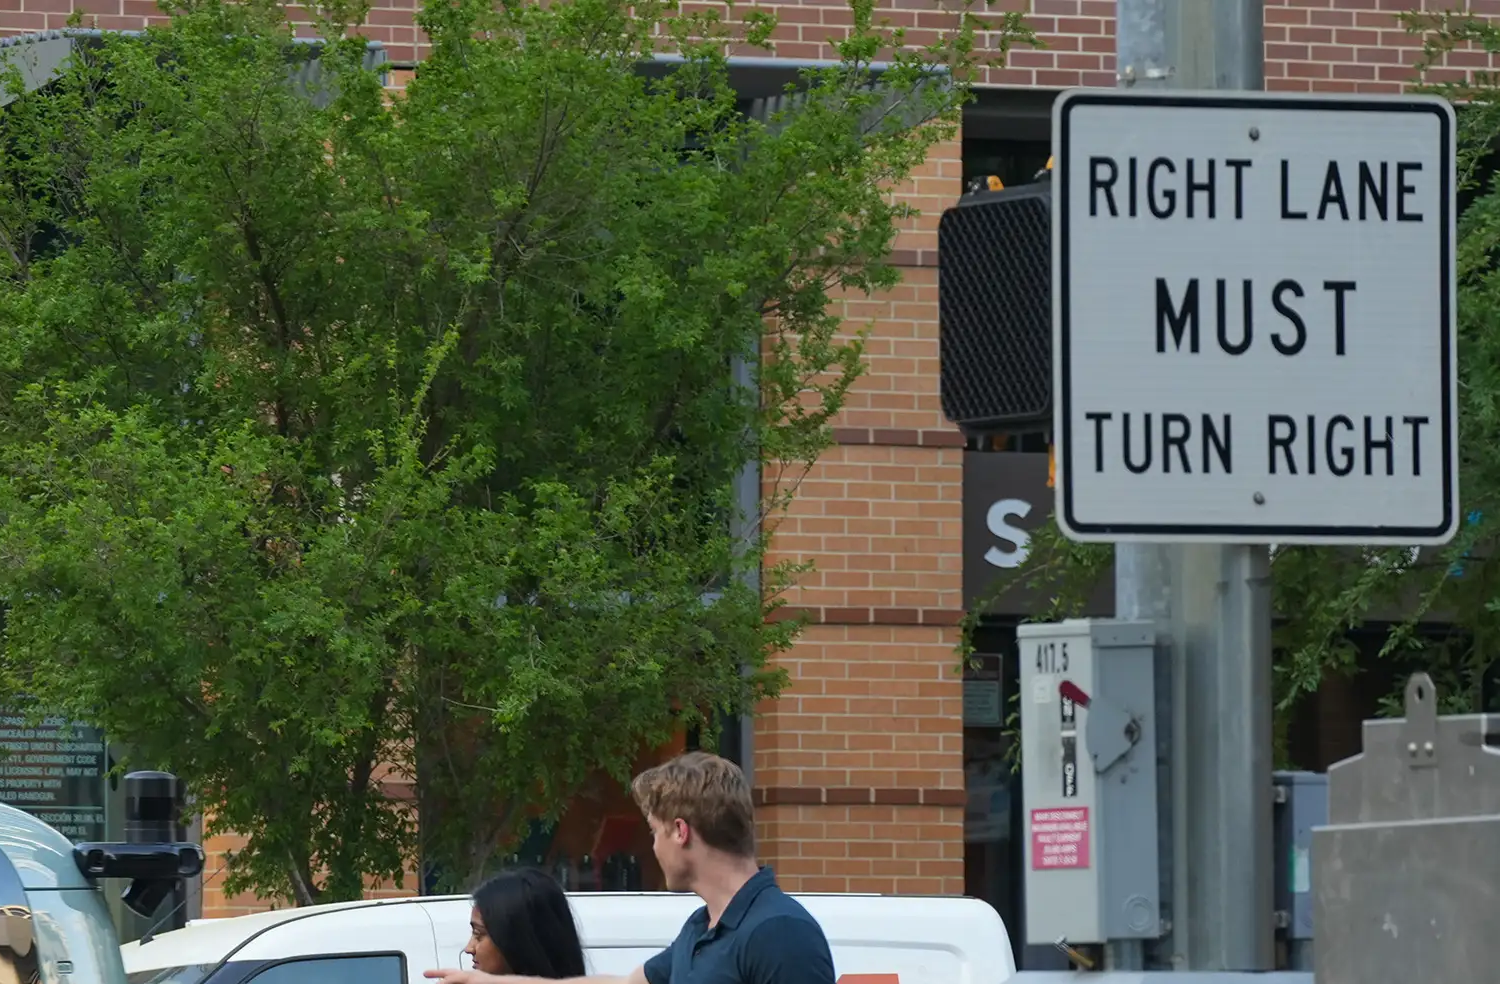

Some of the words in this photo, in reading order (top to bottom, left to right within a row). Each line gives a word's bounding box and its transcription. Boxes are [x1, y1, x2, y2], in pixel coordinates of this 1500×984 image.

[1089, 156, 1252, 219] RIGHT
[1280, 160, 1423, 222] LANE
[1155, 277, 1356, 356] MUST
[1085, 412, 1232, 474] TURN
[1268, 414, 1429, 477] RIGHT
